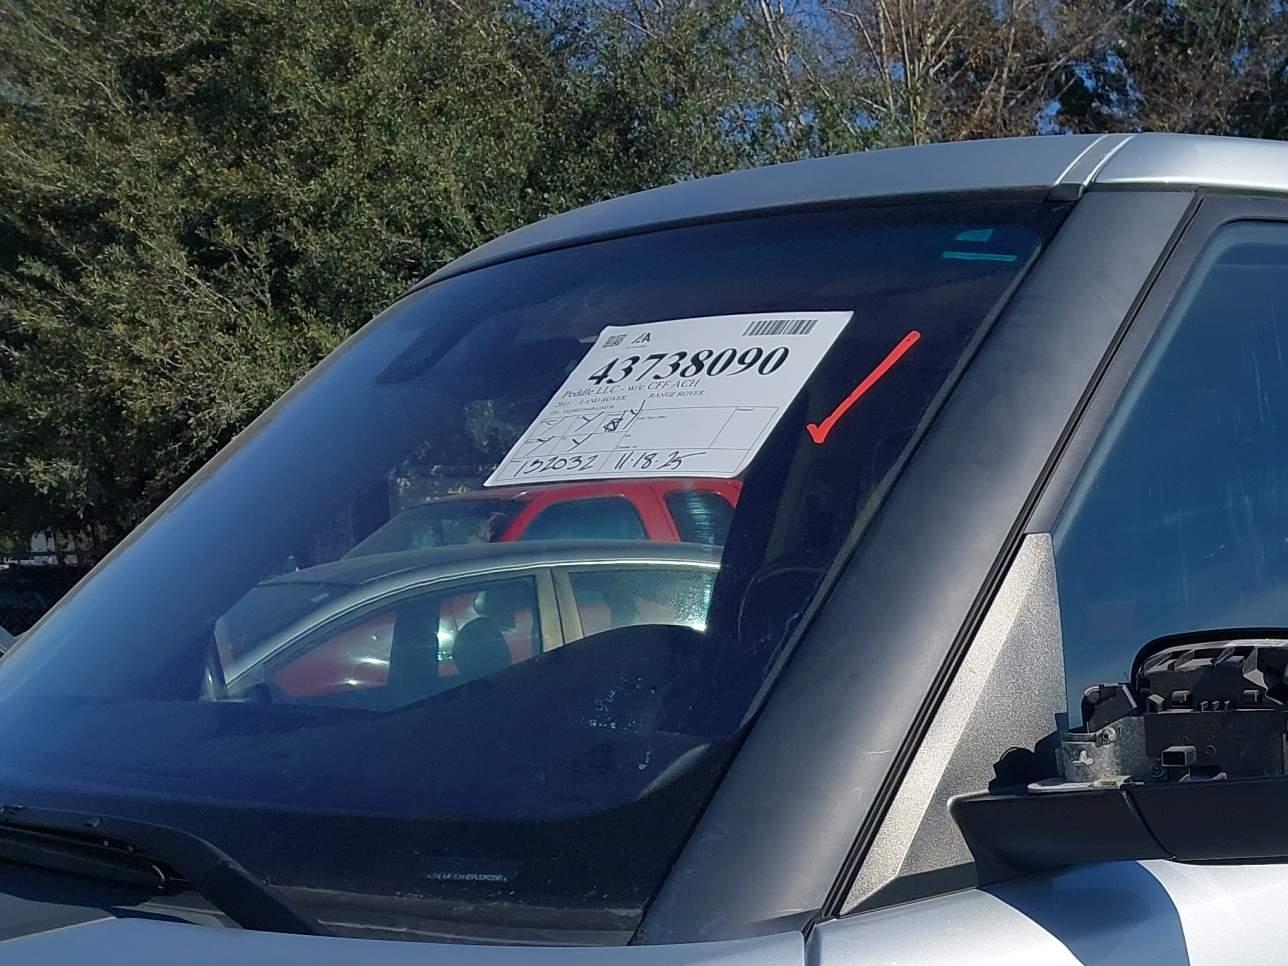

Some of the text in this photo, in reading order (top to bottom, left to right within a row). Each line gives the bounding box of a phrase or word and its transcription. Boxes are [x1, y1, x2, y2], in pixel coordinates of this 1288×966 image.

[588, 346, 789, 386] 43738090
[648, 391, 676, 399] RANGE
[676, 390, 704, 398] ROVER
